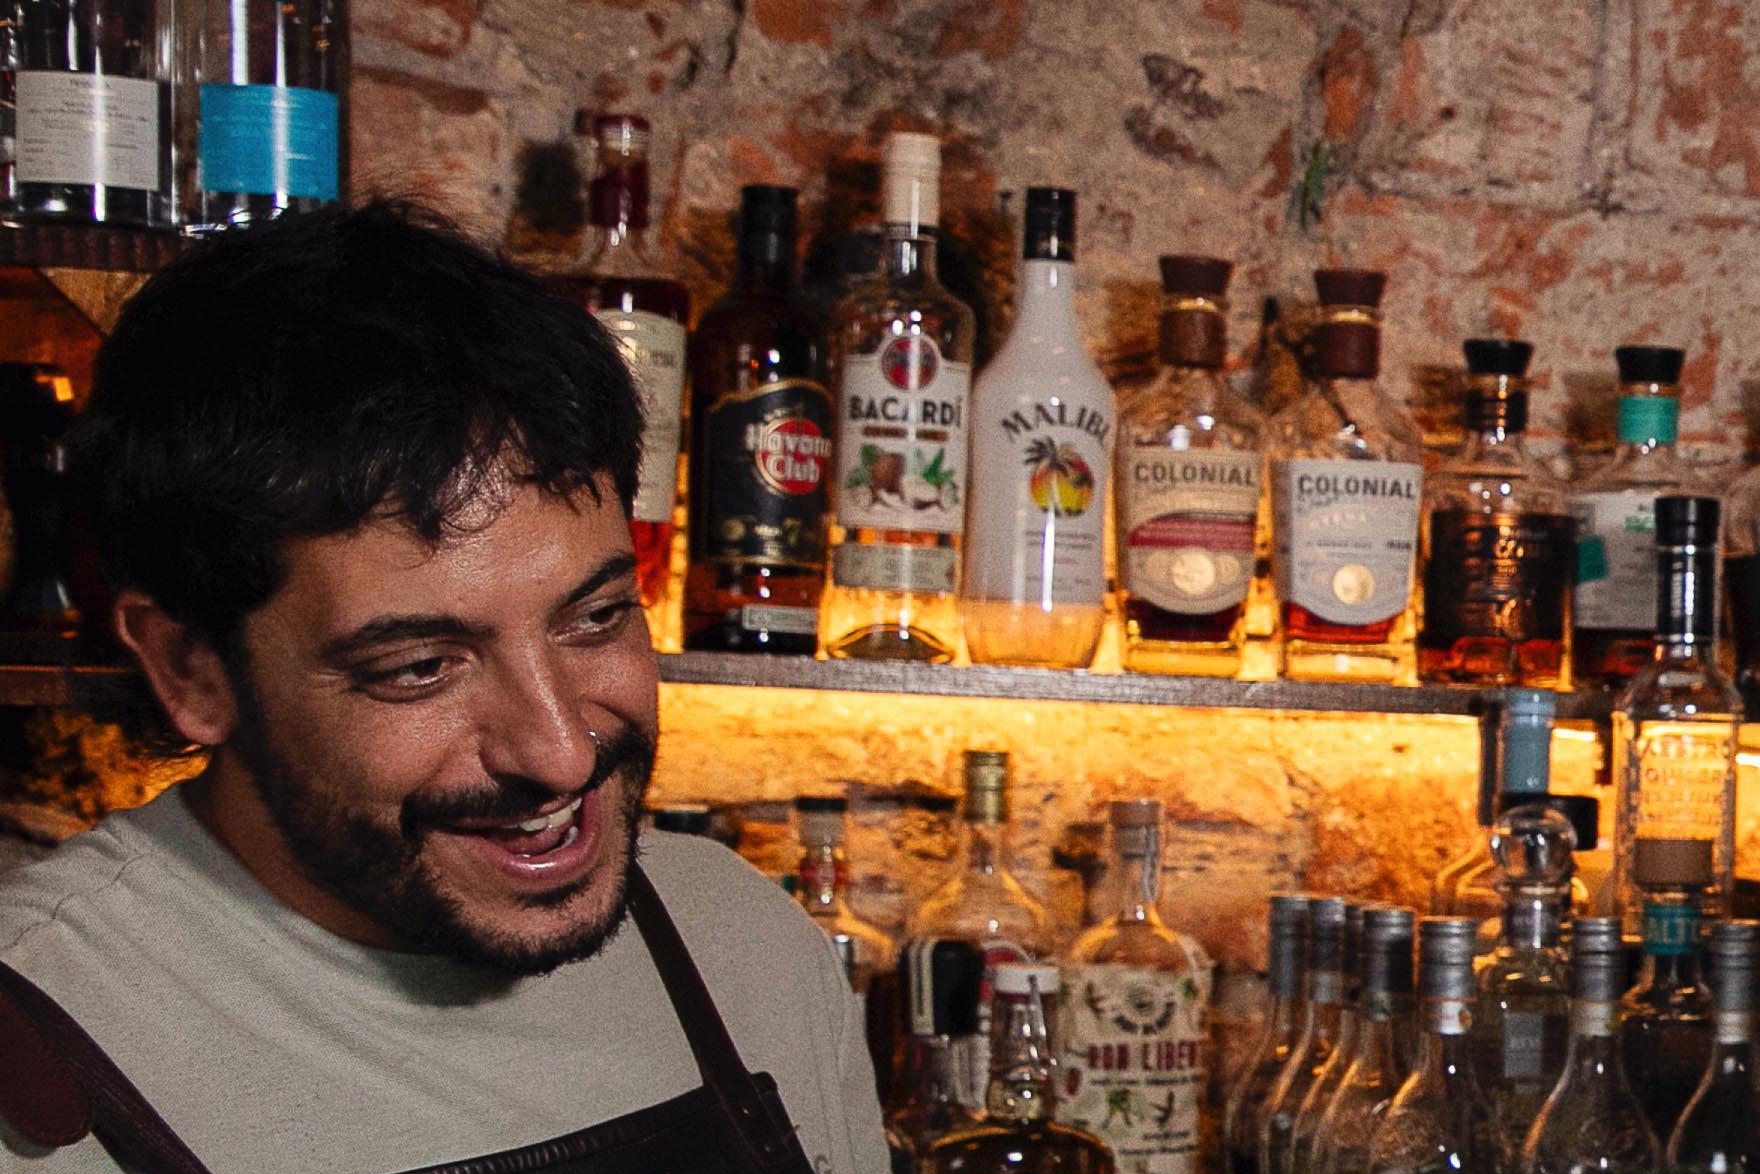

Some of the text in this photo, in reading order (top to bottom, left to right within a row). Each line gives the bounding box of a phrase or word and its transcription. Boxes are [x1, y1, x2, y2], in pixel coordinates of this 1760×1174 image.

[766, 454, 820, 483] Club
[1135, 462, 1254, 486] COLONIAL
[1298, 474, 1416, 499] COLONIAL
